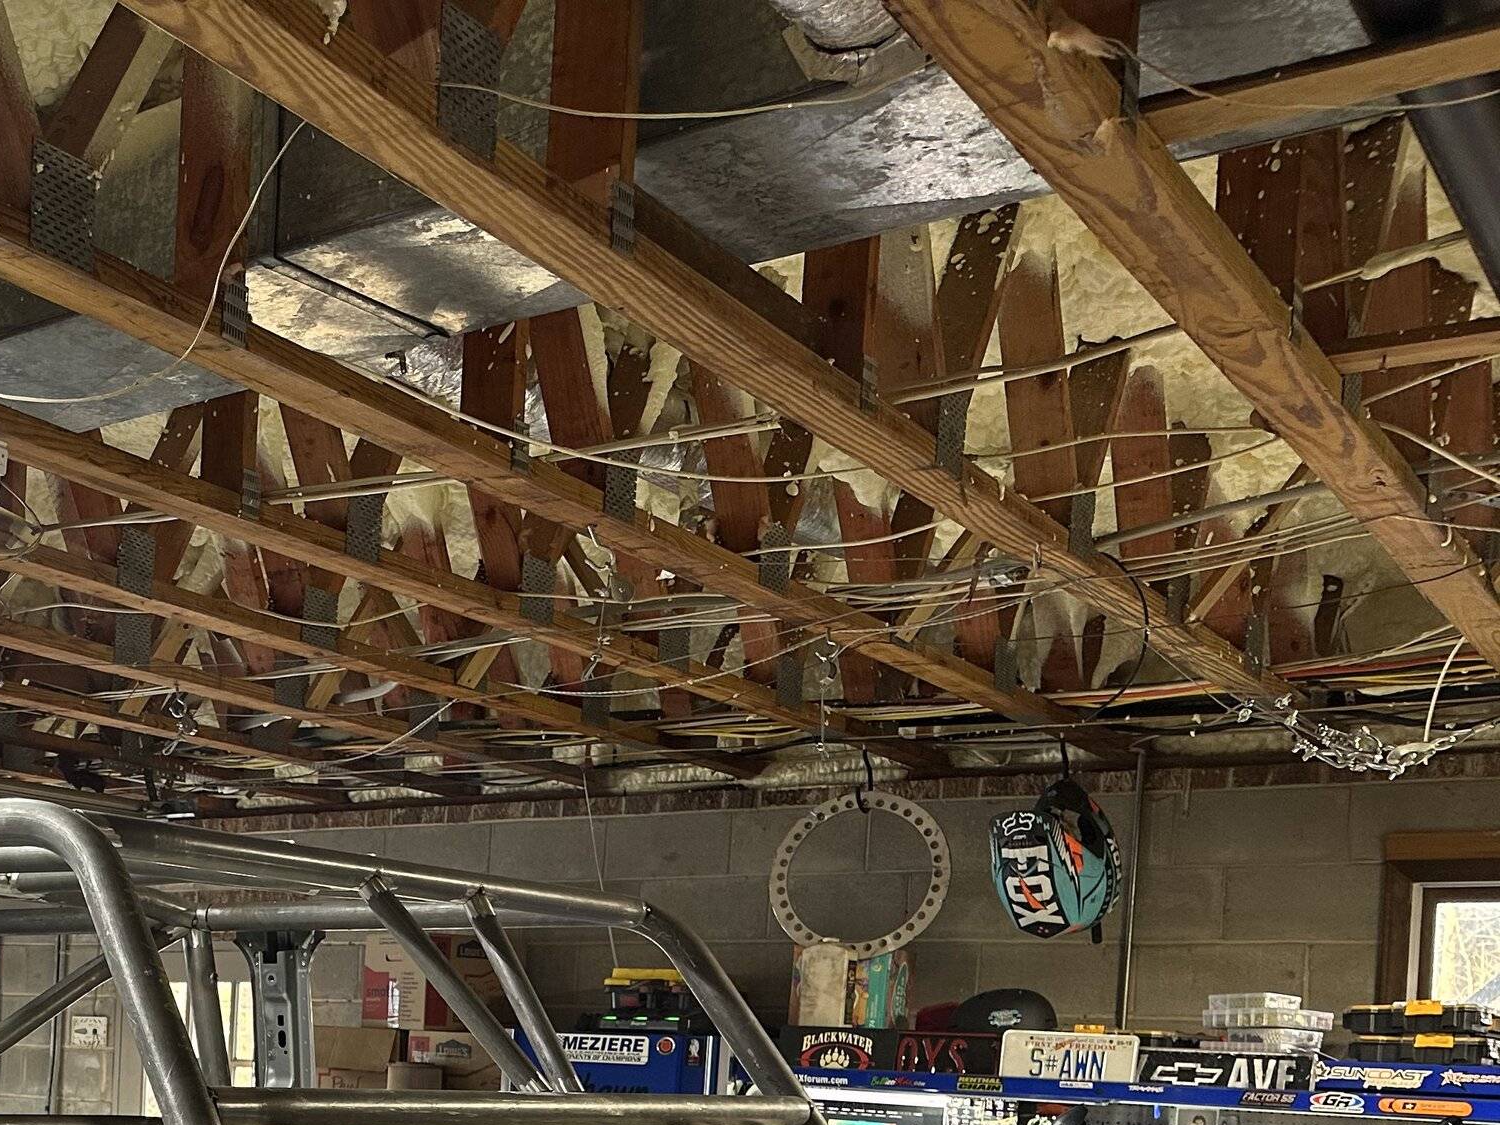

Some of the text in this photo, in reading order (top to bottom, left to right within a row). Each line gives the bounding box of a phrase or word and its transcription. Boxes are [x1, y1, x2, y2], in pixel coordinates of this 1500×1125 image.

[1001, 845, 1065, 928] FOX
[563, 1035, 646, 1054] MEZIERE
[801, 1031, 874, 1055] BLACKWATER
[1025, 1040, 1051, 1048] FIRST
[1069, 1042, 1117, 1051] FREEDOM
[958, 1076, 1001, 1084] RENTHAL
[1331, 1066, 1430, 1082] SUNCOAST
[958, 1083, 1002, 1092] CHAIN
[1243, 1092, 1281, 1102] FACTOR
